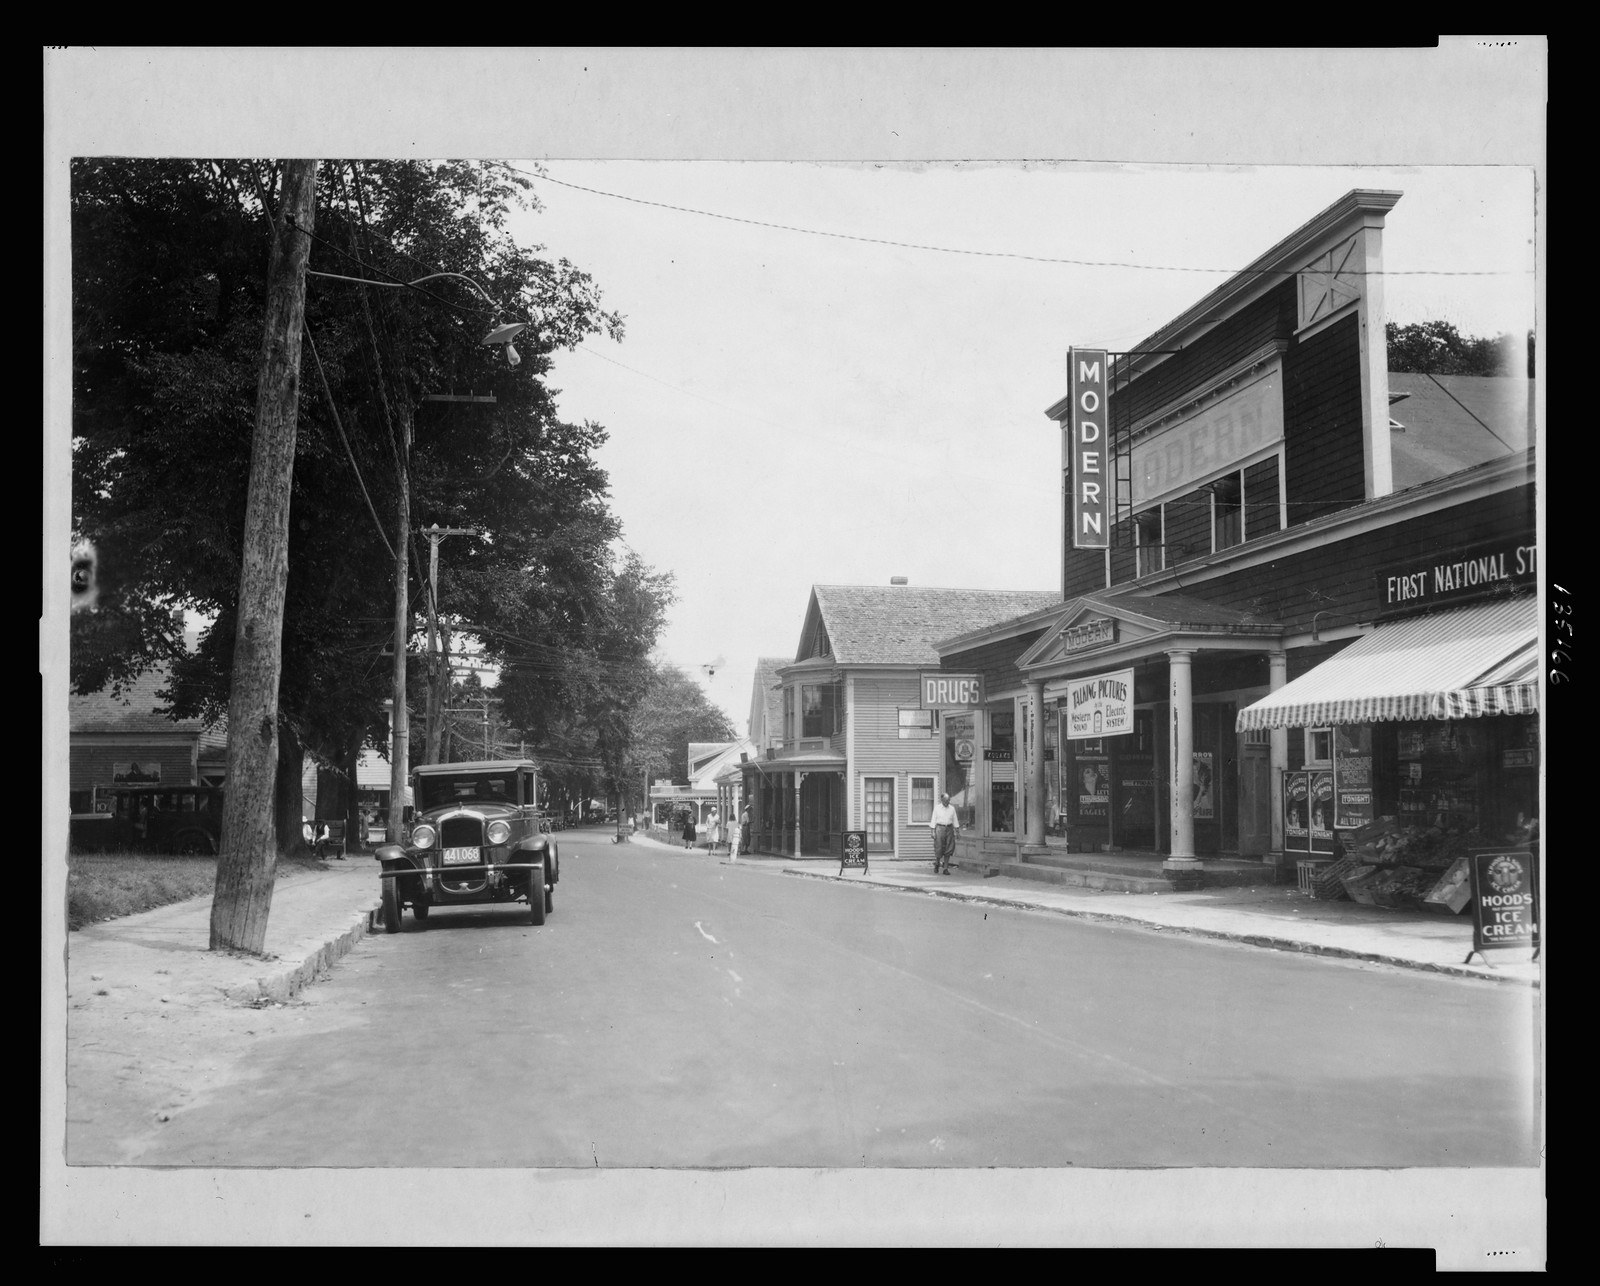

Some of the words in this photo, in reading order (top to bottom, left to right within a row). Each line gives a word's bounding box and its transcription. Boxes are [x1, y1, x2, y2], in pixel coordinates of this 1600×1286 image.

[1079, 360, 1102, 535] MODERN
[1387, 571, 1427, 604] FIRST
[1434, 552, 1510, 594] NATIONAL
[1516, 545, 1538, 576] ST
[926, 679, 980, 704] DRUGS
[1072, 682, 1097, 710] TALKING
[1098, 679, 1128, 702] PICTURES
[1105, 704, 1127, 718] Electric
[1286, 828, 1309, 837] TONIGHT
[1311, 830, 1333, 840] TONIGHT
[1481, 892, 1534, 907] HOOD'S
[1494, 911, 1523, 924] ICE
[1482, 922, 1538, 937] CREAM
